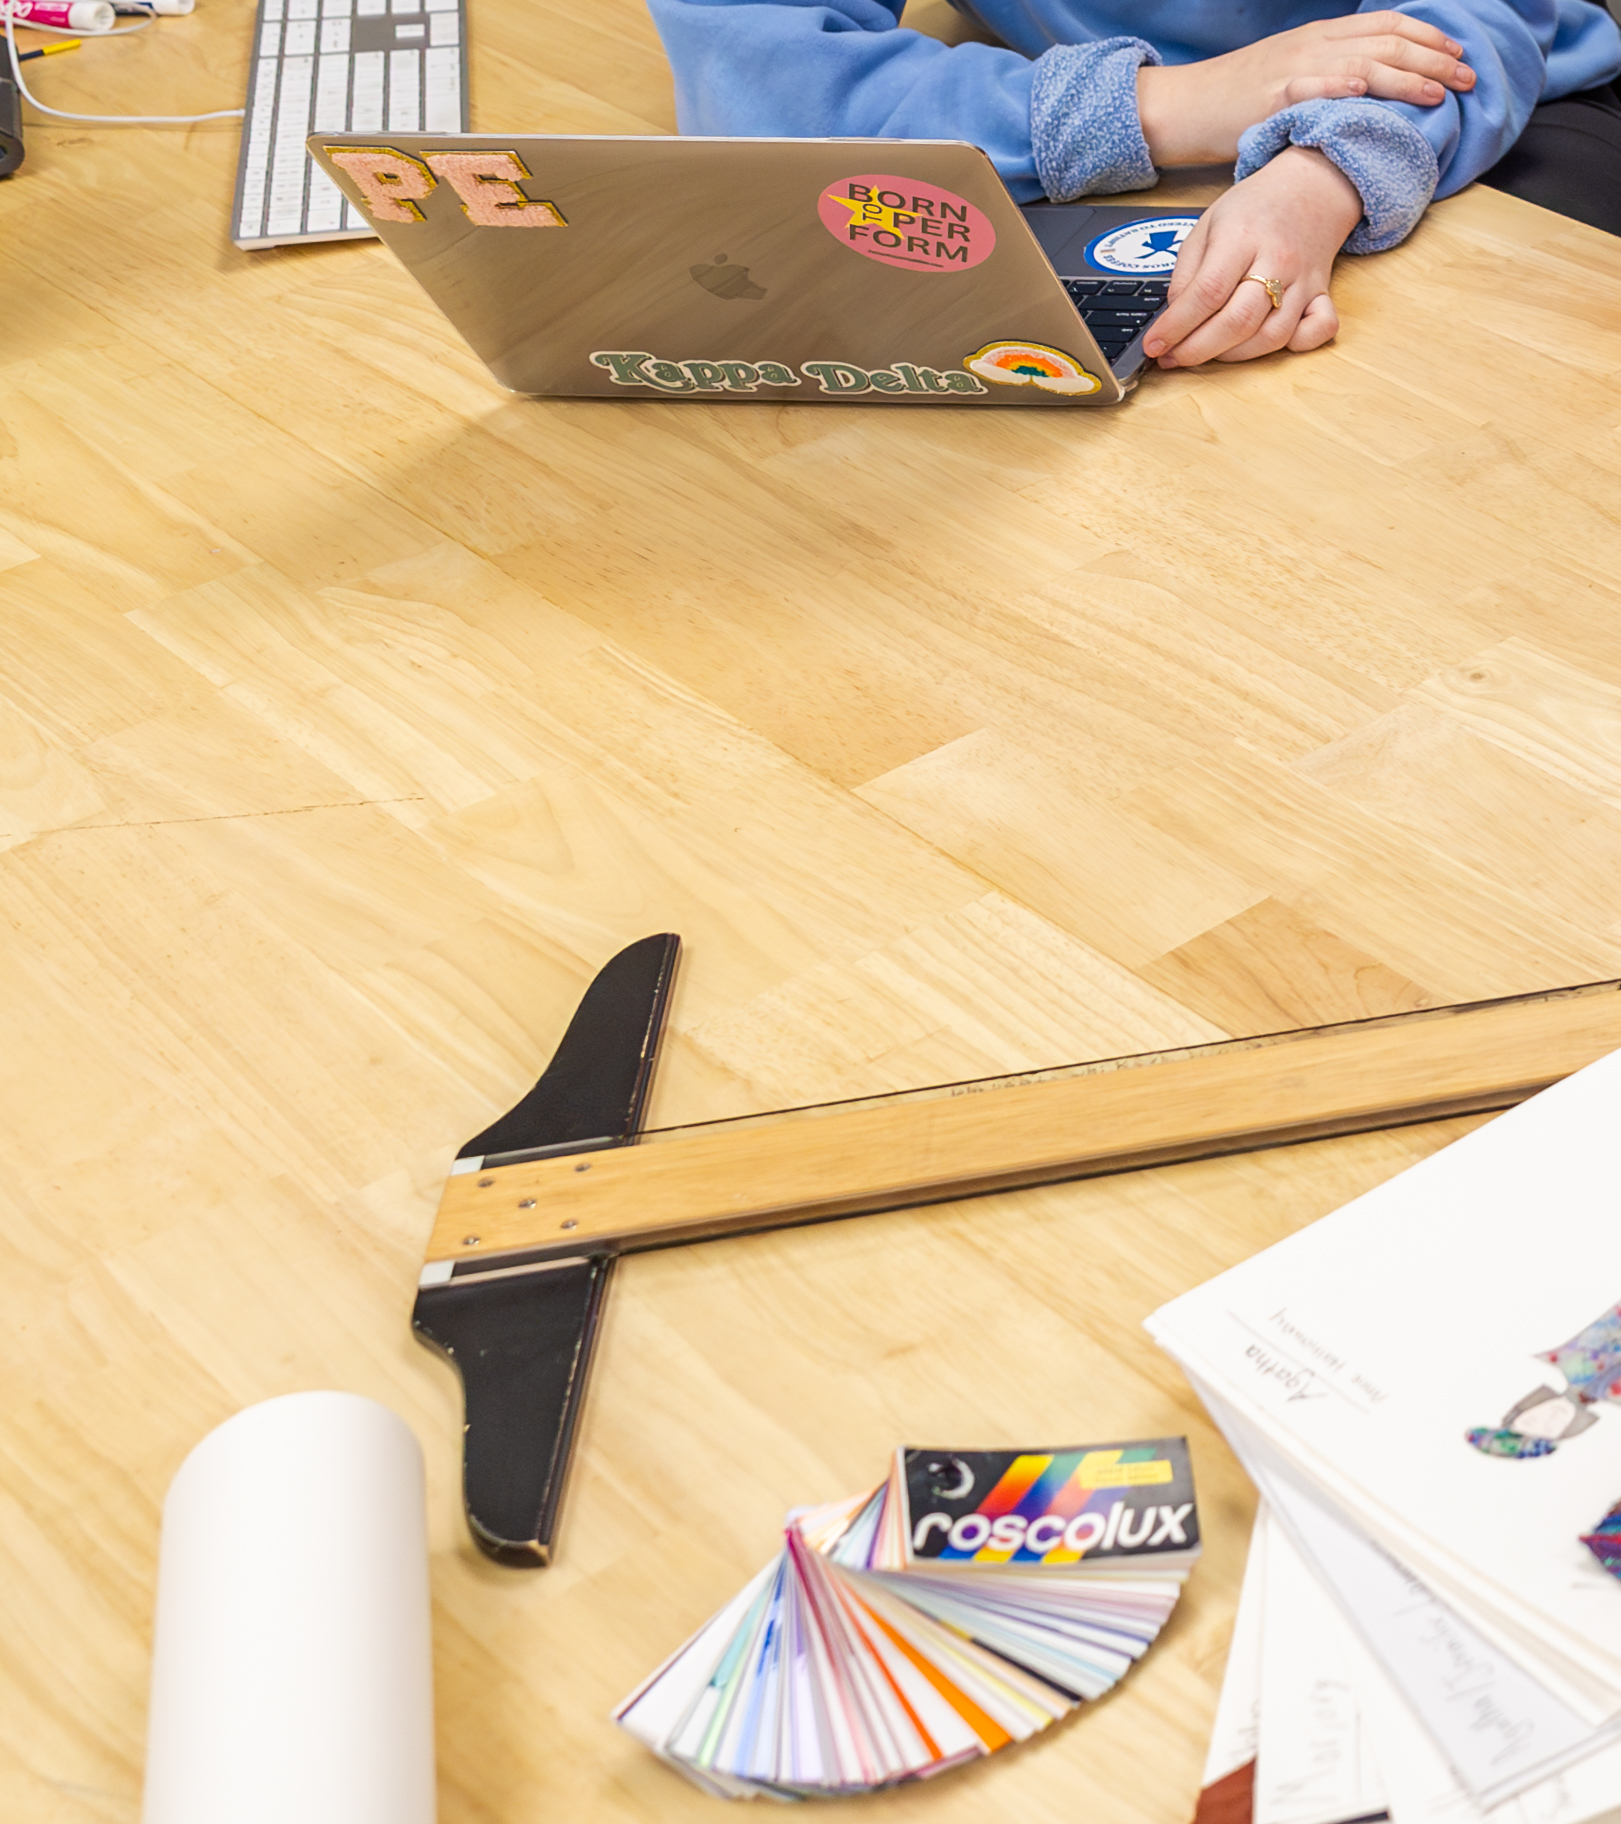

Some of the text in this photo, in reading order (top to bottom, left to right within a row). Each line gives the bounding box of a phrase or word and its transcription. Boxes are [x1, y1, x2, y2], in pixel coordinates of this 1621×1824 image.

[848, 183, 967, 223] BORN
[862, 203, 882, 222] TO
[849, 223, 968, 263] FORM
[893, 212, 971, 243] PER
[594, 352, 985, 394] Kappa Delta
[1245, 1342, 1328, 1402] Agatha
[912, 1500, 1195, 1554] roscolux
